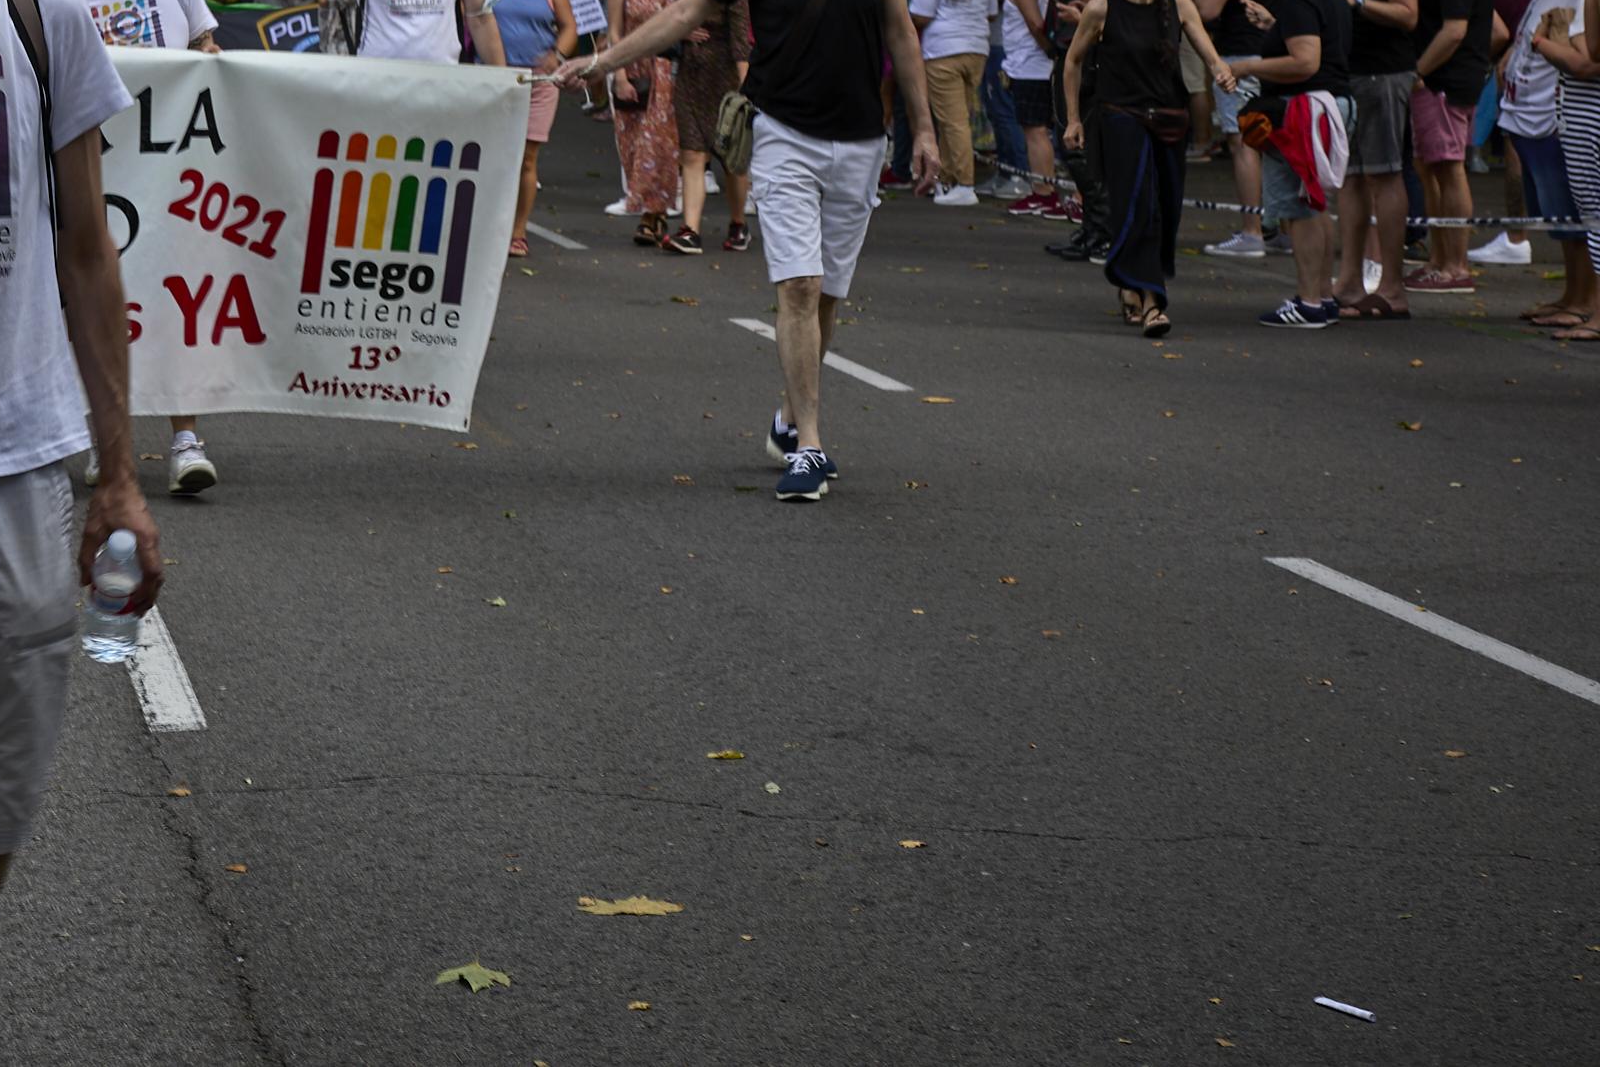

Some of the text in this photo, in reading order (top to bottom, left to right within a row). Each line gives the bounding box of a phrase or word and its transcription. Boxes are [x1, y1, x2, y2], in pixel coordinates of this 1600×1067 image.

[269, 12, 320, 45] POL
[137, 86, 226, 155] LA
[168, 168, 287, 260] 2021
[329, 259, 435, 300] sego
[163, 274, 267, 347] YA
[297, 297, 461, 329] entiende
[294, 322, 458, 347] Asociación LGTBH Segovia
[288, 370, 452, 408] Aniversario
